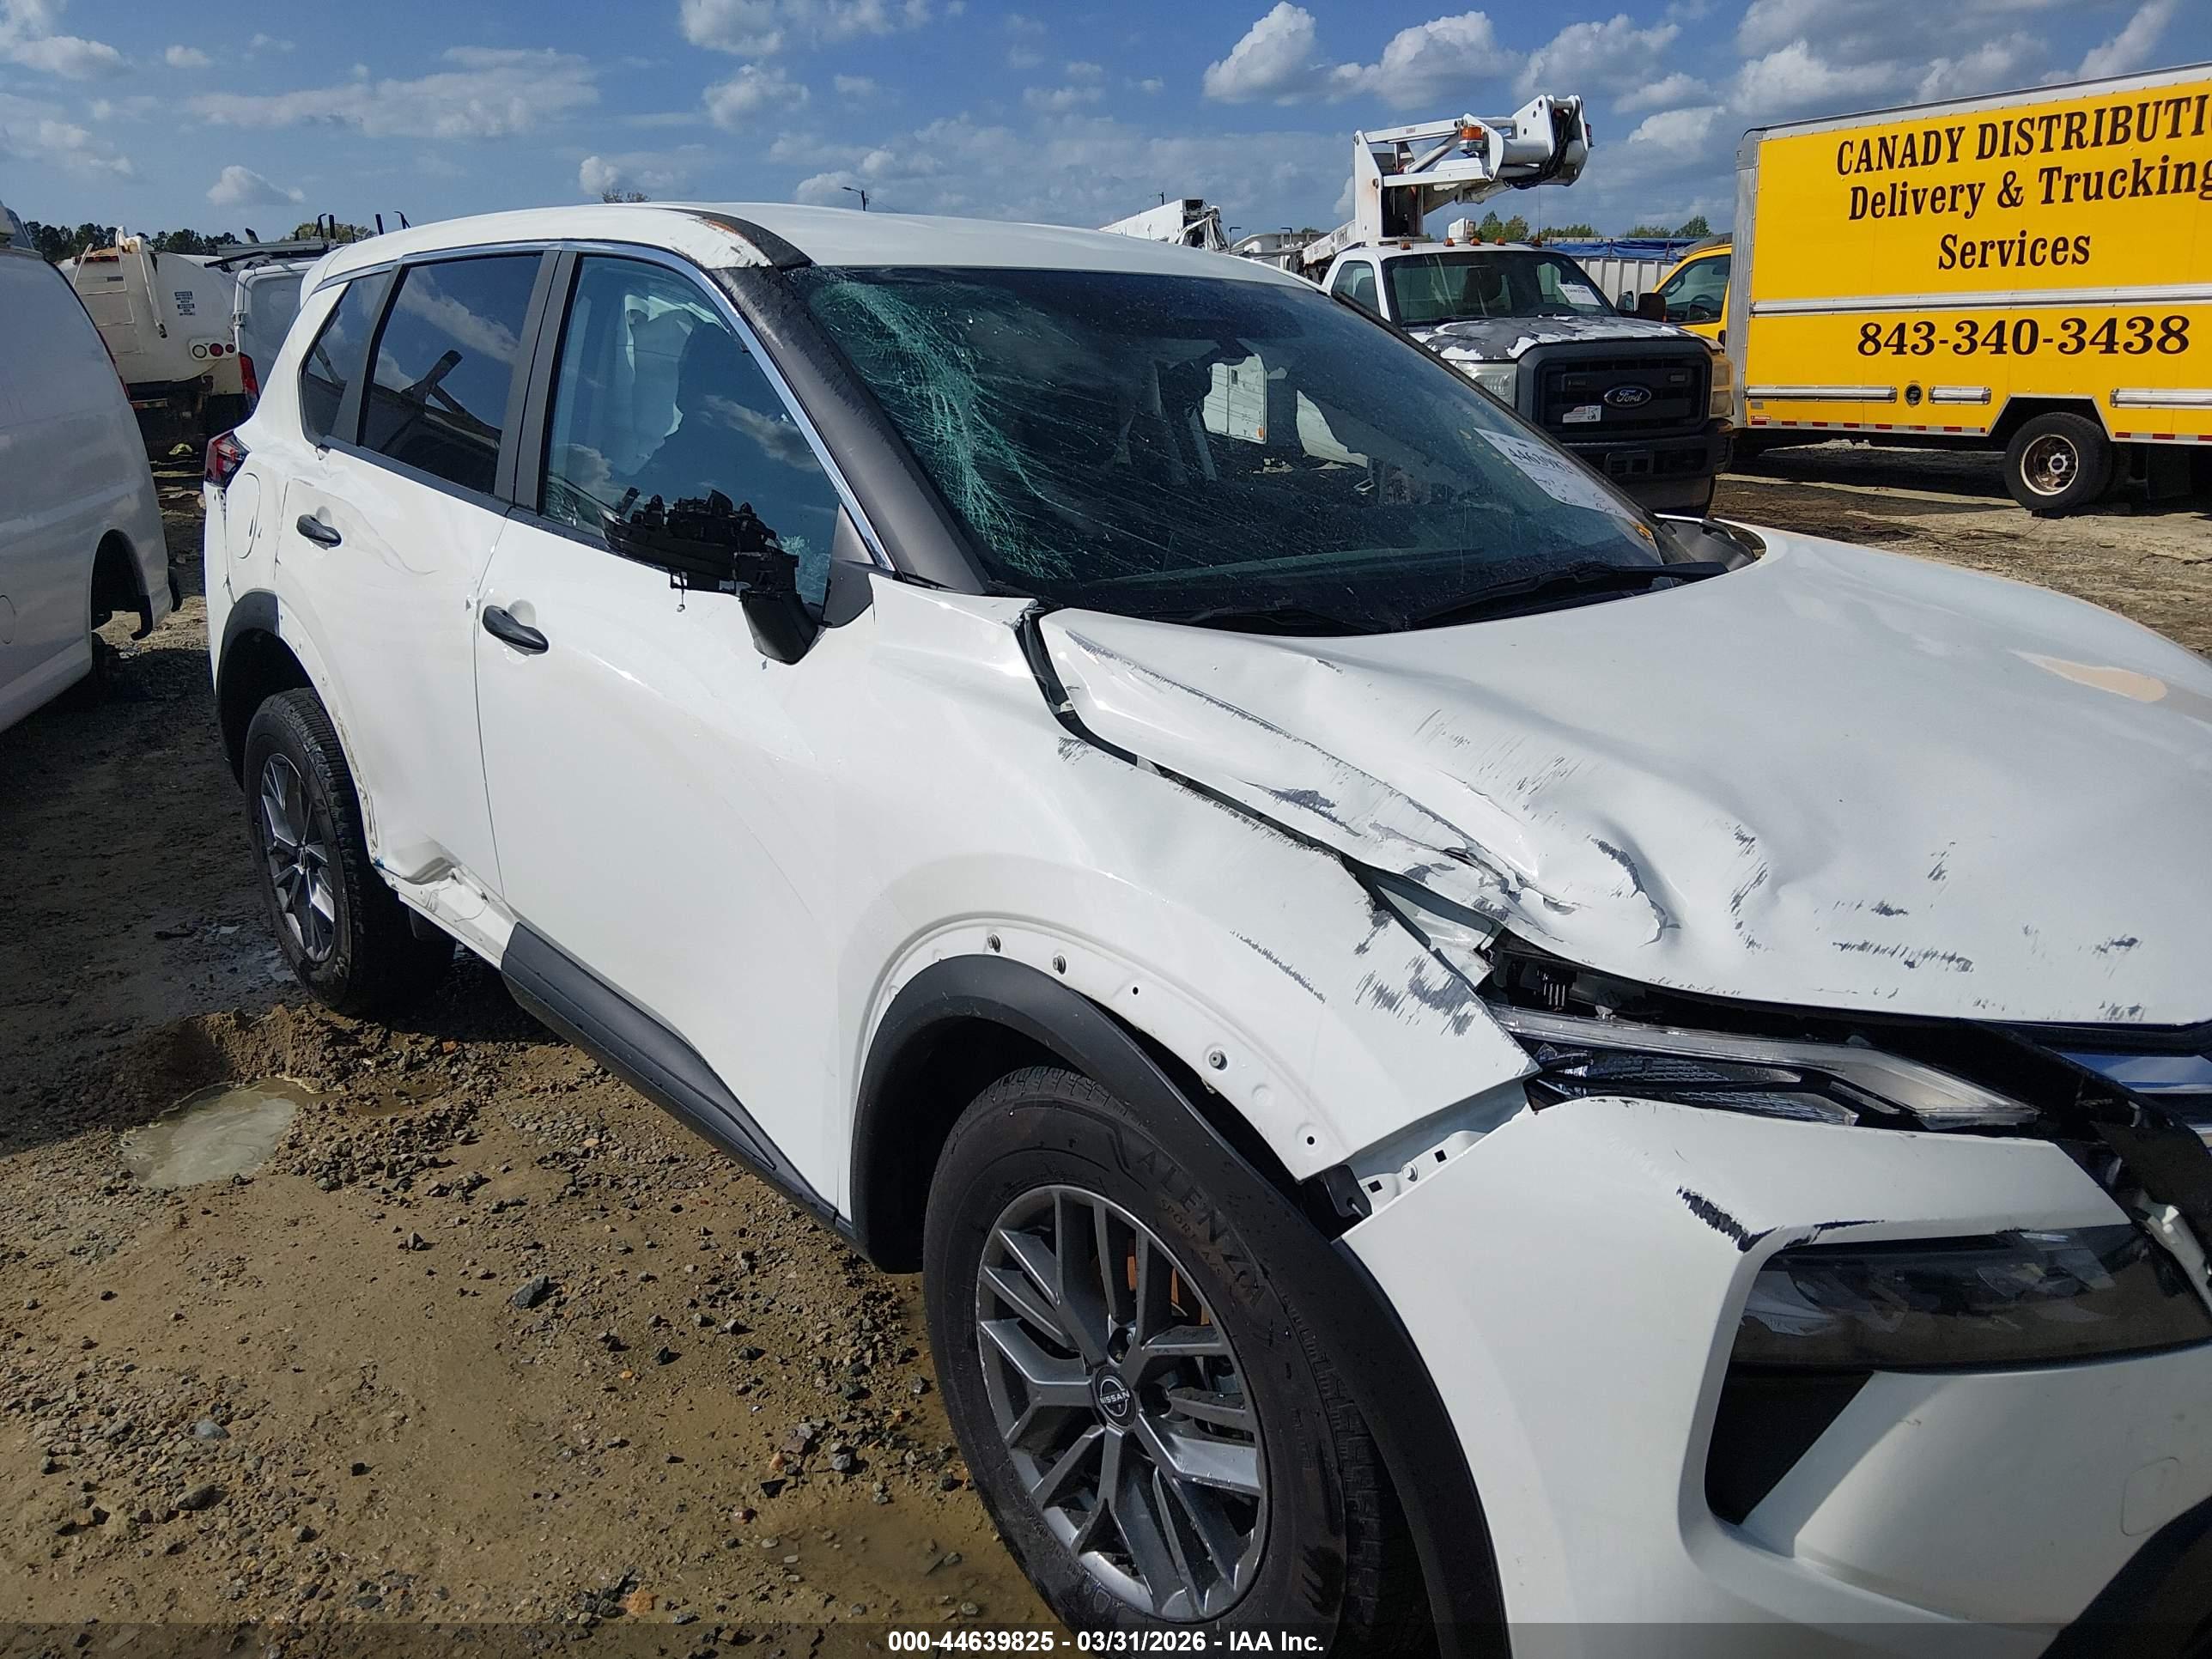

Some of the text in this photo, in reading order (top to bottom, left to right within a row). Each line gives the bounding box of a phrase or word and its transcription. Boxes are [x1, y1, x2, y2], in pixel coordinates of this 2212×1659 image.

[1837, 94, 2212, 177] CANADY DISTRIBUTI
[1849, 180, 1987, 221] Delivery
[1996, 170, 2025, 209] &
[1938, 229, 2092, 270] Services
[1856, 314, 2191, 357] 843-340-3438
[1615, 389, 1644, 404] Ford
[1099, 1389, 1131, 1405] NISSAN
